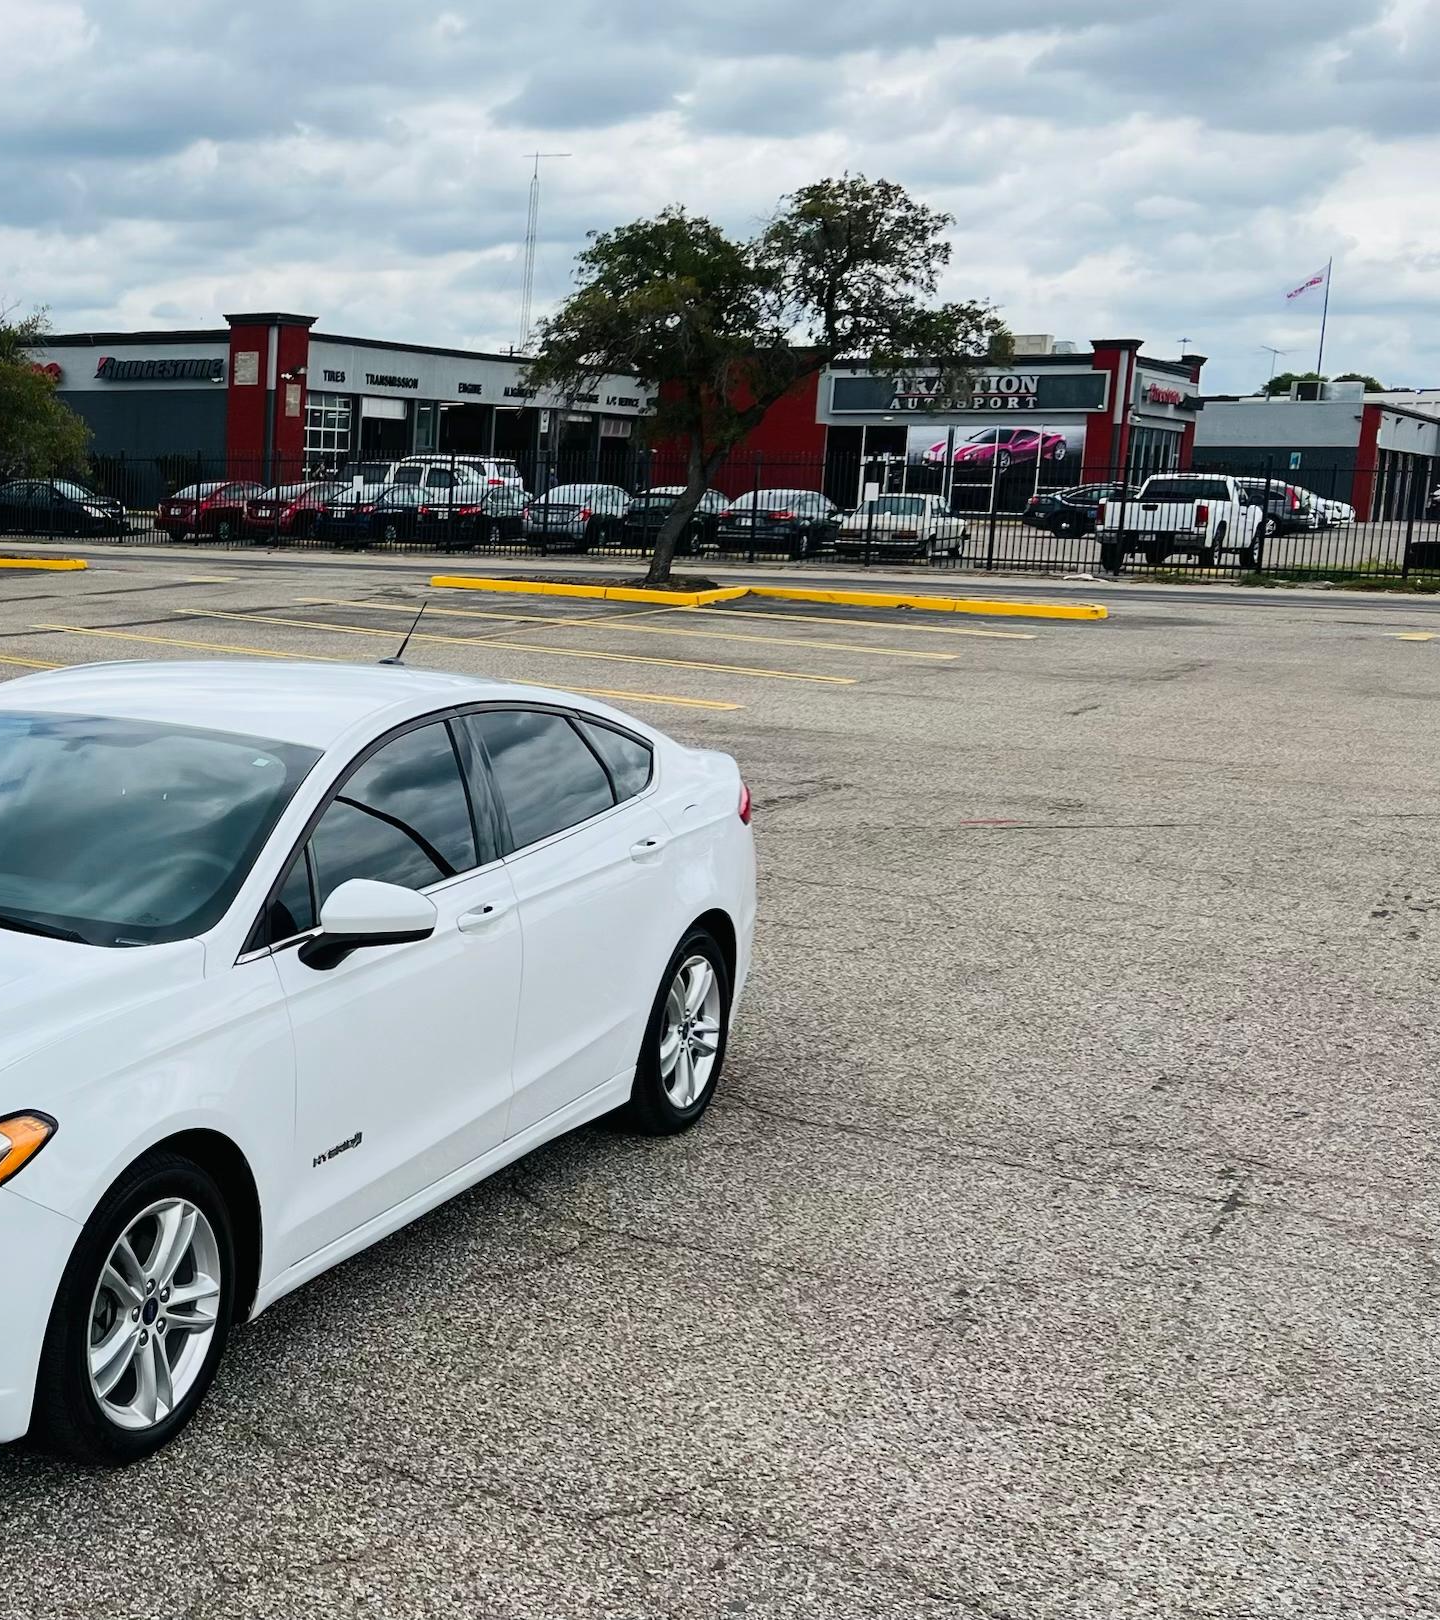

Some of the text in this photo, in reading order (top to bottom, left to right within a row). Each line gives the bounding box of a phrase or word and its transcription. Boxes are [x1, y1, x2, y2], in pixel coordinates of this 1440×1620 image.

[94, 357, 224, 379] BRIDGESTONE
[323, 370, 345, 383] TIRES
[366, 373, 419, 389] TRANSMISSION
[458, 382, 482, 395] ENGINE
[312, 1138, 355, 1168] HYBRID
